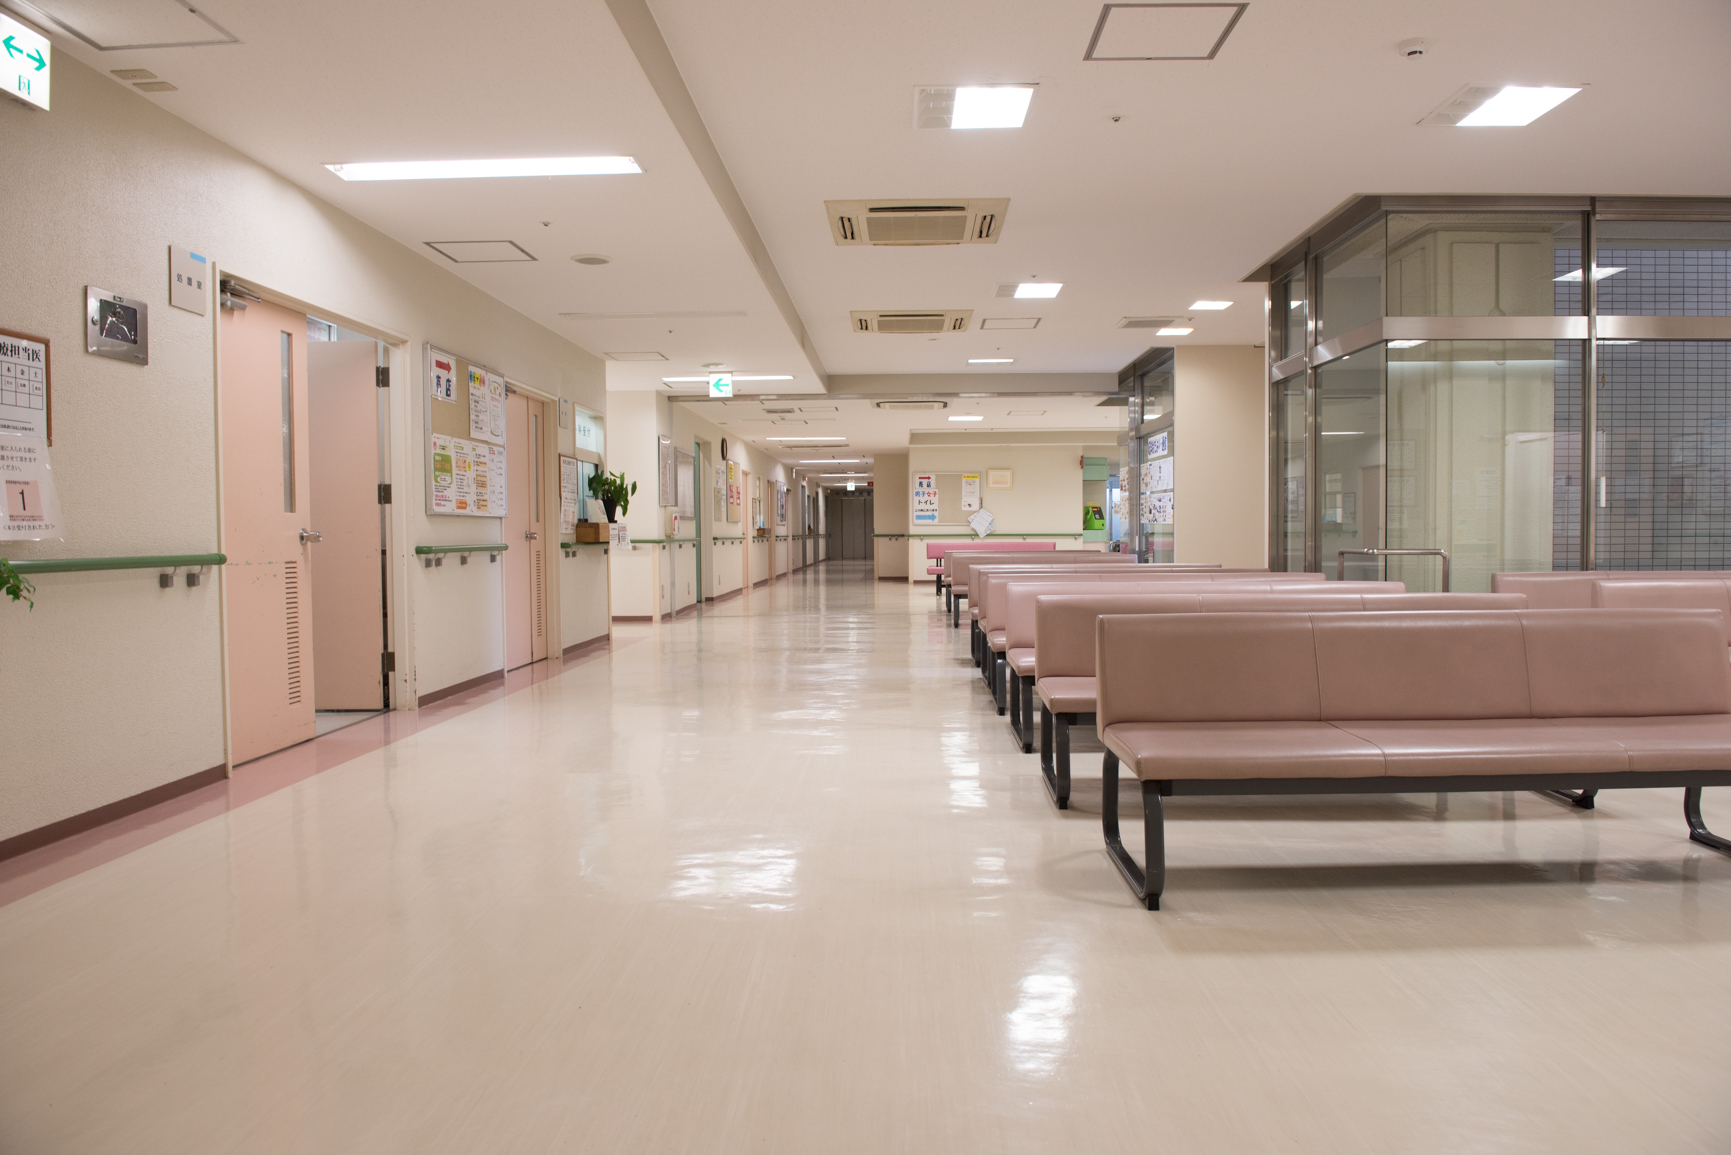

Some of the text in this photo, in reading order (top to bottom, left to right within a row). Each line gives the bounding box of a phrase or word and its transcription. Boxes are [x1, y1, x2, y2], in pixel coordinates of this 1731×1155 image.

[176, 273, 203, 290] 処置室
[6, 366, 12, 374] 木
[20, 368, 26, 377] 金
[436, 374, 452, 397] 売店
[19, 489, 26, 511] 1
